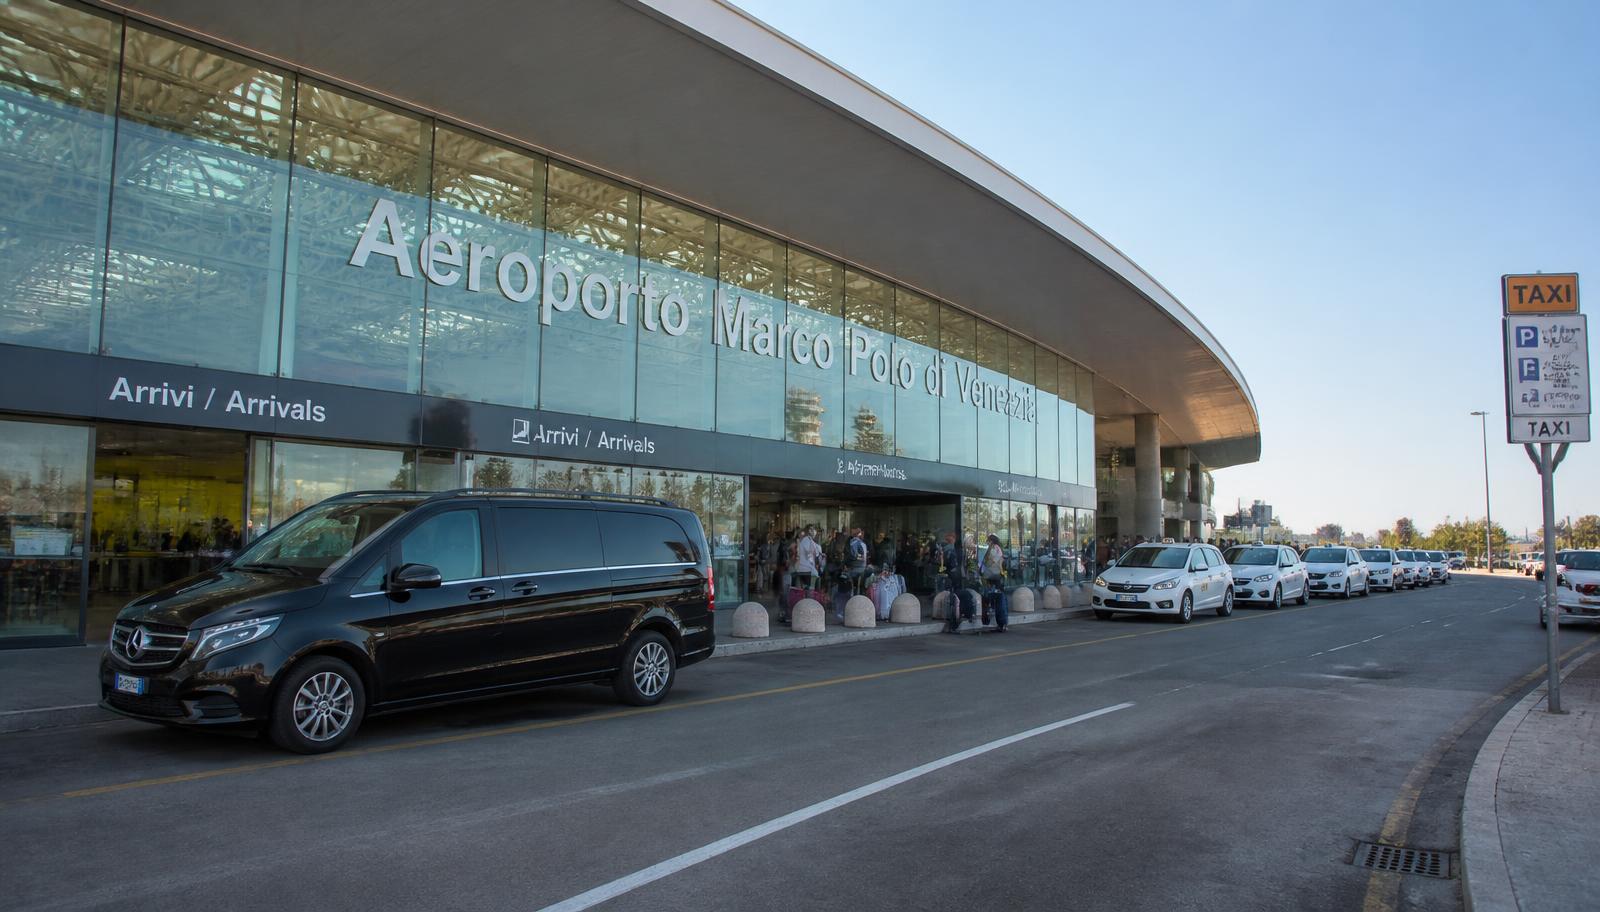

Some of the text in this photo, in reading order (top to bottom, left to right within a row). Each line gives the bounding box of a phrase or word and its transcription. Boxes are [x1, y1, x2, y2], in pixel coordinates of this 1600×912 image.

[349, 198, 690, 337] Aeroporto
[712, 287, 834, 370] Marco
[850, 328, 915, 390] Polo
[925, 353, 947, 398] di
[1513, 284, 1571, 304] TAXI
[109, 376, 326, 422] Arrivi / Arrivals
[533, 424, 655, 454] Arrivi / Arrivals
[1528, 421, 1570, 437] TAXI
